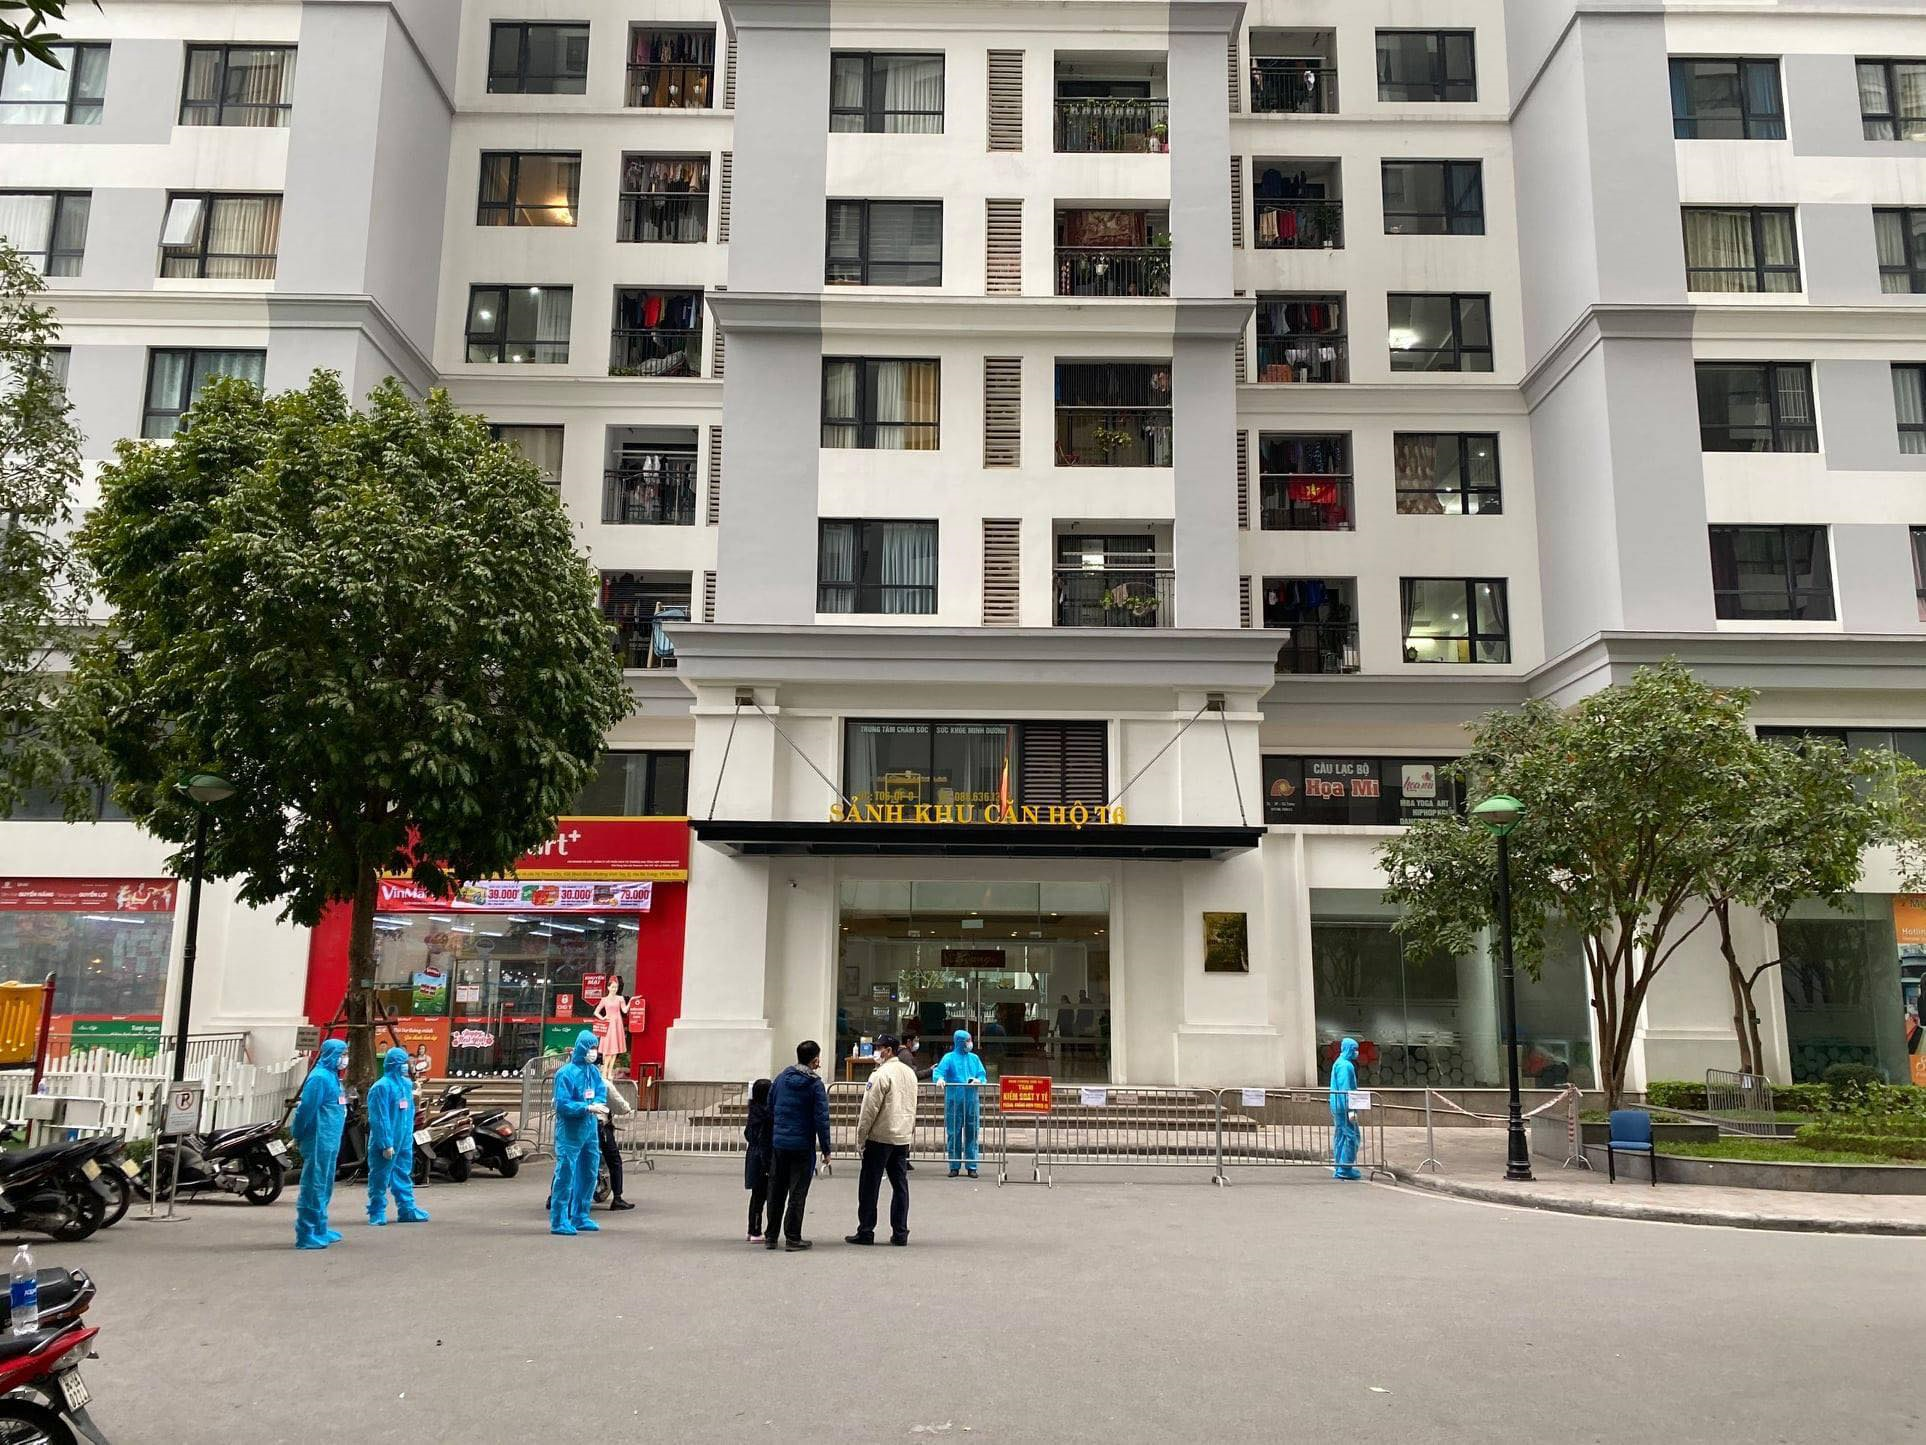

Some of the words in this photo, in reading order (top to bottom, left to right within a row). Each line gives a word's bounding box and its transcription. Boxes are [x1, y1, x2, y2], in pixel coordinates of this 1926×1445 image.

[1335, 763, 1354, 777] LẠC
[1356, 761, 1370, 777] BỘ
[1305, 777, 1345, 800] Họa
[1351, 778, 1380, 798] Mi
[1416, 799, 1434, 807] YOGA
[1436, 799, 1450, 807] ART
[830, 796, 904, 824] SẢNH
[914, 804, 975, 824] KHU
[984, 800, 1040, 825] CĂN
[1048, 800, 1089, 830] HỘ
